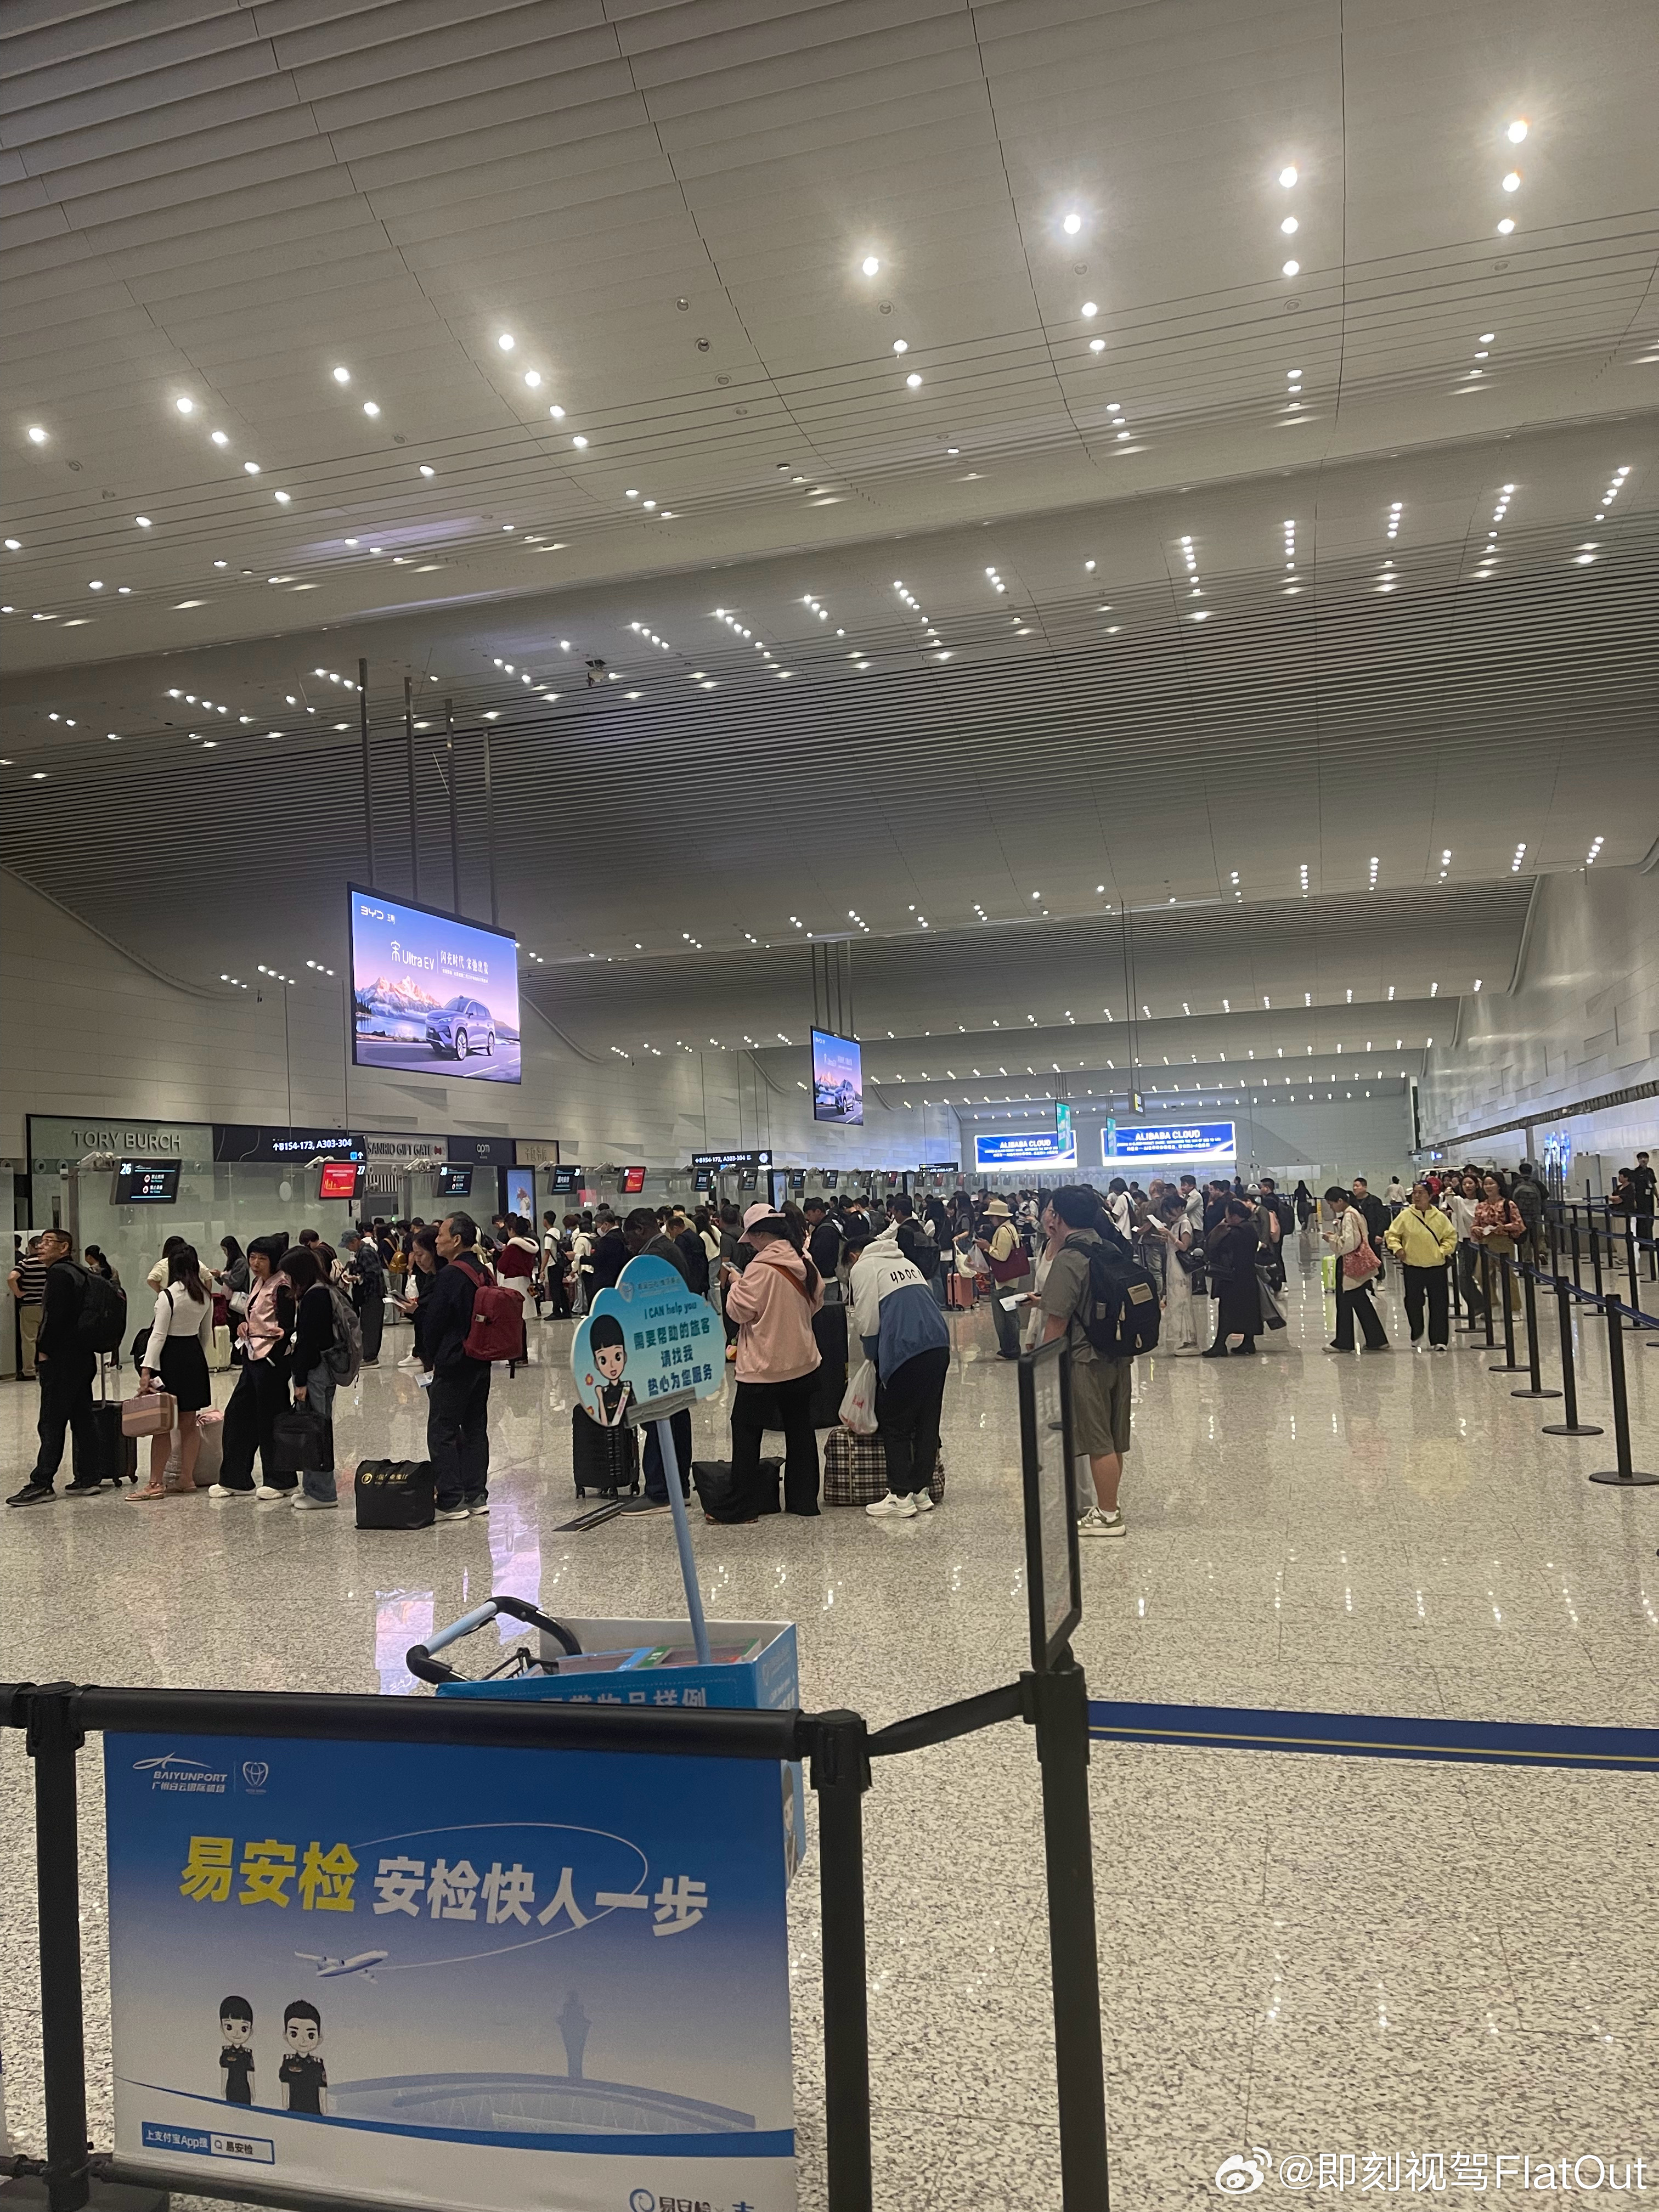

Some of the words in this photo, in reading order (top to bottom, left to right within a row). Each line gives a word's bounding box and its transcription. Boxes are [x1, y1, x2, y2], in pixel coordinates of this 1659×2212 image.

[360, 905, 384, 920] BYD
[402, 950, 422, 967] Ultra
[424, 956, 435, 970] EV
[441, 950, 465, 969] 闪充时代
[72, 1130, 120, 1149] TORY
[125, 1132, 181, 1152] BURCH
[1135, 1131, 1171, 1141] ALIBABA
[1172, 1130, 1201, 1139] CLOUD
[279, 1141, 315, 1150] B154-173,
[315, 1138, 352, 1149] A303-304
[368, 1142, 396, 1155] SANRIO
[396, 1143, 411, 1156] GIFT
[1000, 1140, 1028, 1149] ALIBABA
[1028, 1139, 1052, 1147] CLOUD
[120, 1163, 132, 1175] 26
[357, 1165, 365, 1175] 27
[648, 1307, 664, 1318] CAN
[666, 1302, 682, 1316] help
[684, 1302, 697, 1314] you
[634, 1317, 710, 1350] 需要帮助的旅客
[661, 1344, 693, 1368] 请找我
[647, 1363, 712, 1397] 热心为您服务
[154, 1771, 228, 1782] BAIYUNPORT
[151, 1781, 225, 1793] 广州白云国际机场
[178, 1835, 359, 1912] 易安检
[372, 1855, 709, 1937] 安检快人一步
[226, 2141, 254, 2155] 易安检
